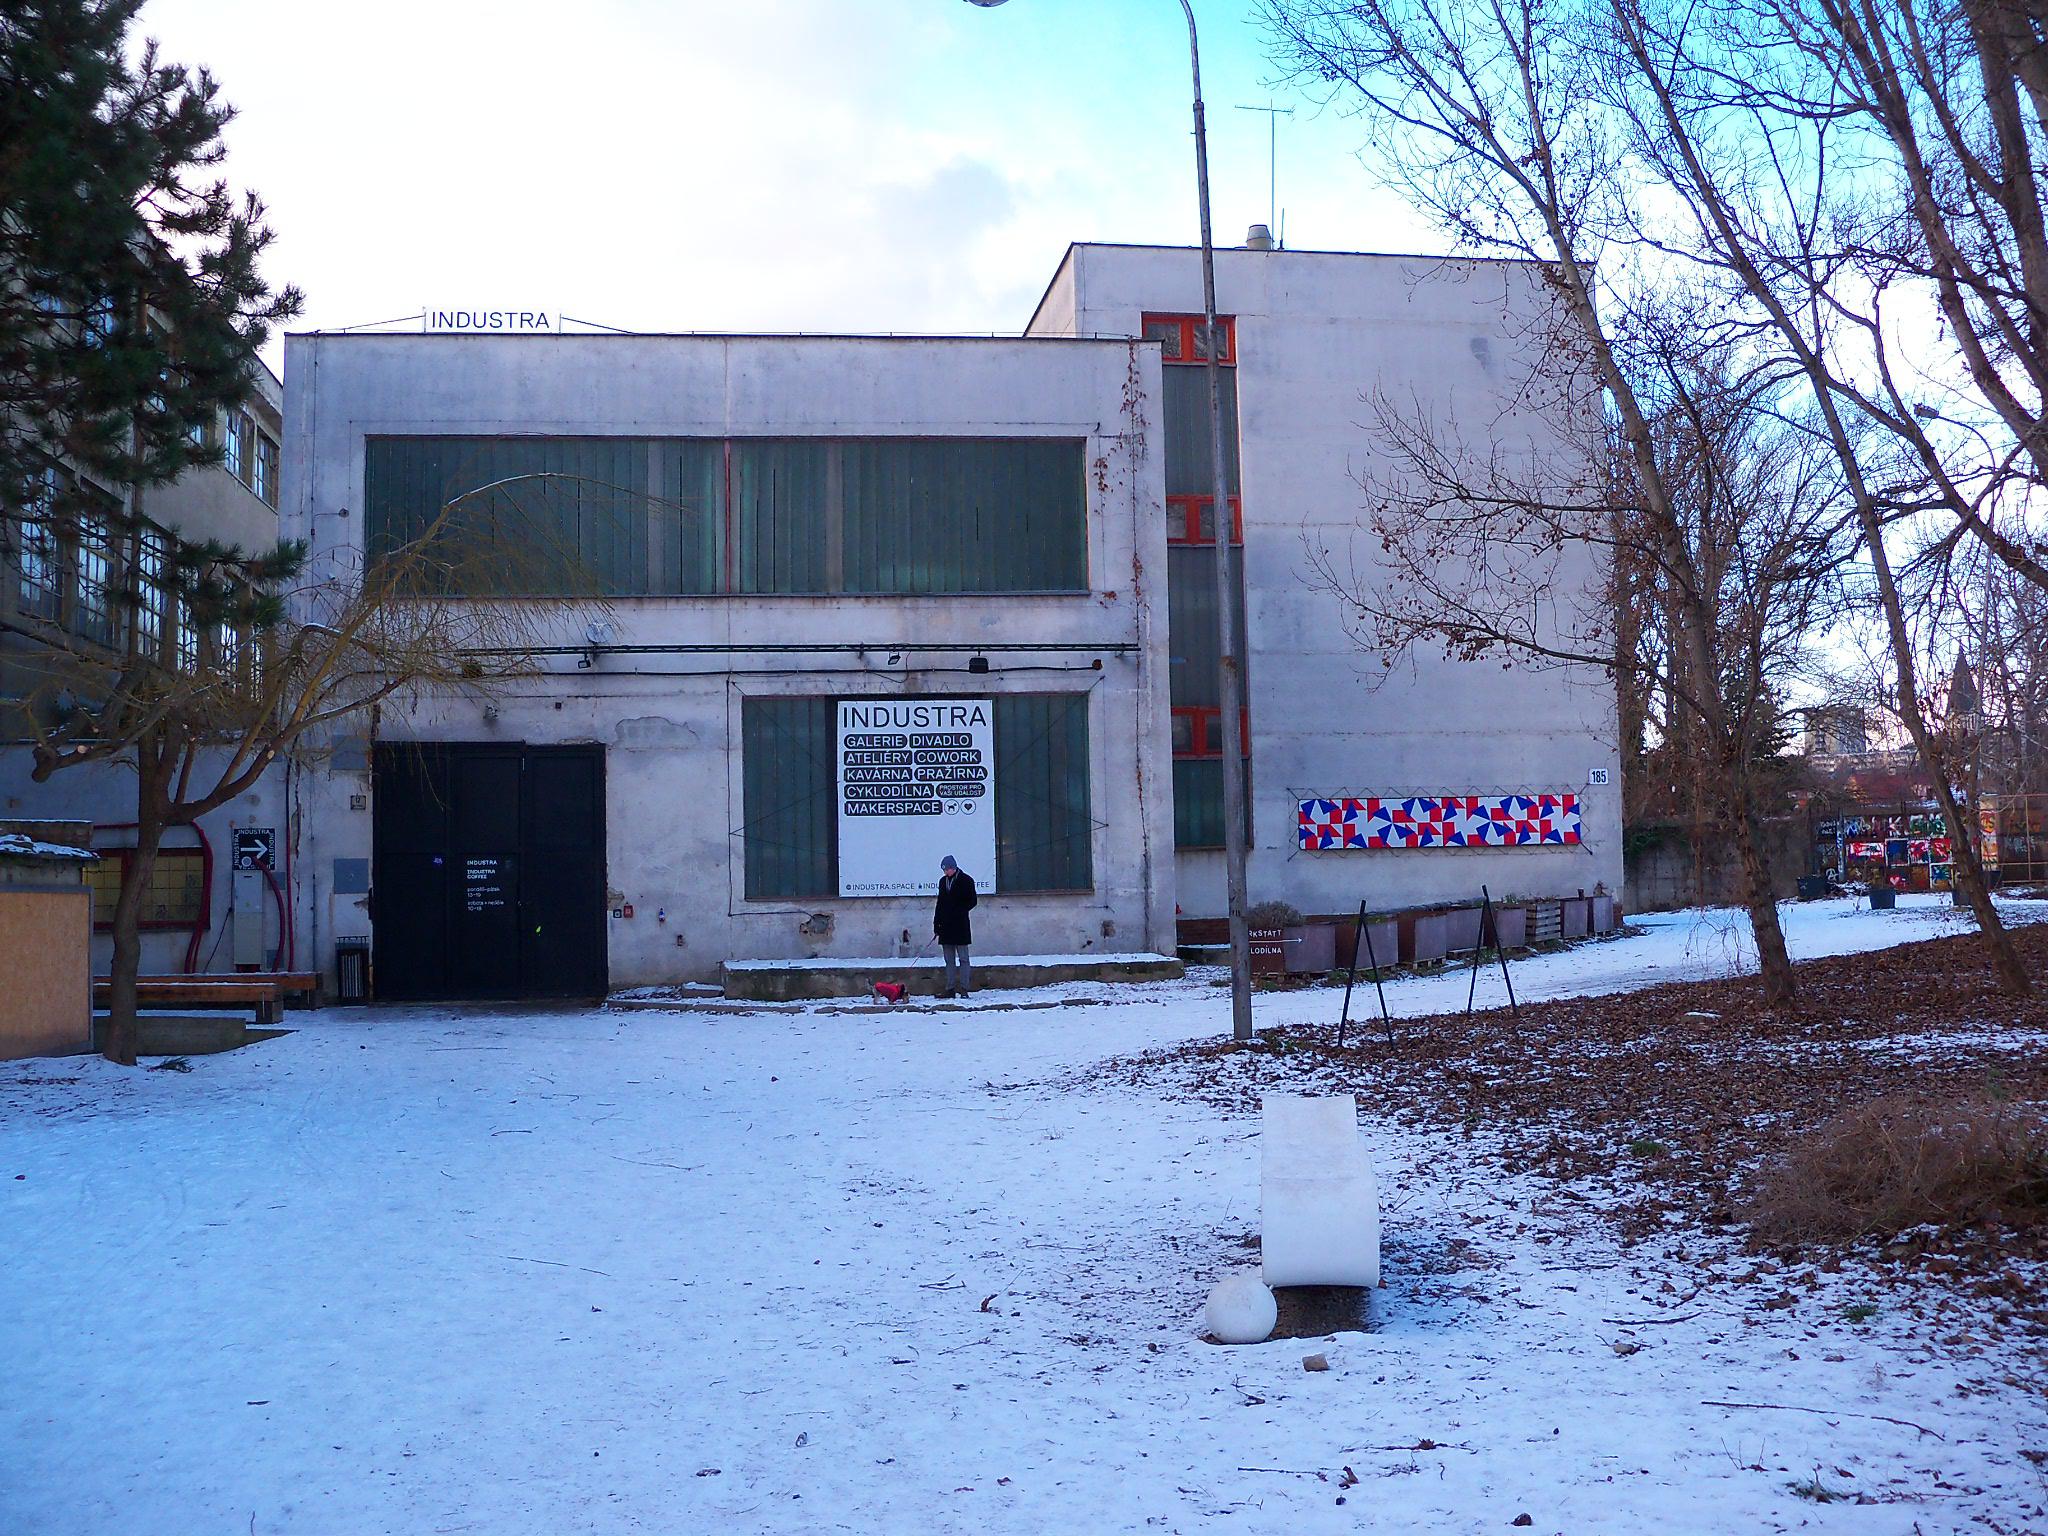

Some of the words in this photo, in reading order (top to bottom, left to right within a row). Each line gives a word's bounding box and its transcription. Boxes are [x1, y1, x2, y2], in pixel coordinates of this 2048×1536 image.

[432, 311, 550, 329] INDUSTRA
[843, 705, 987, 729] INDUSTRA
[846, 736, 903, 747] GALERIE
[912, 735, 970, 747] DIVADLO
[846, 750, 910, 764] ATELIÉRY
[916, 751, 978, 763] COWORK
[846, 766, 910, 780] KAVÁRNA
[917, 765, 985, 780] PRAŽÍRNA
[1591, 770, 1606, 783] 185
[846, 784, 932, 797] CYKLODÍLNA
[847, 801, 940, 814] MAKERSPACE
[852, 882, 915, 891] INDUSTRA.SPACE
[1248, 929, 1281, 938] RKSTATT
[1250, 944, 1282, 954] LODÍLNA
